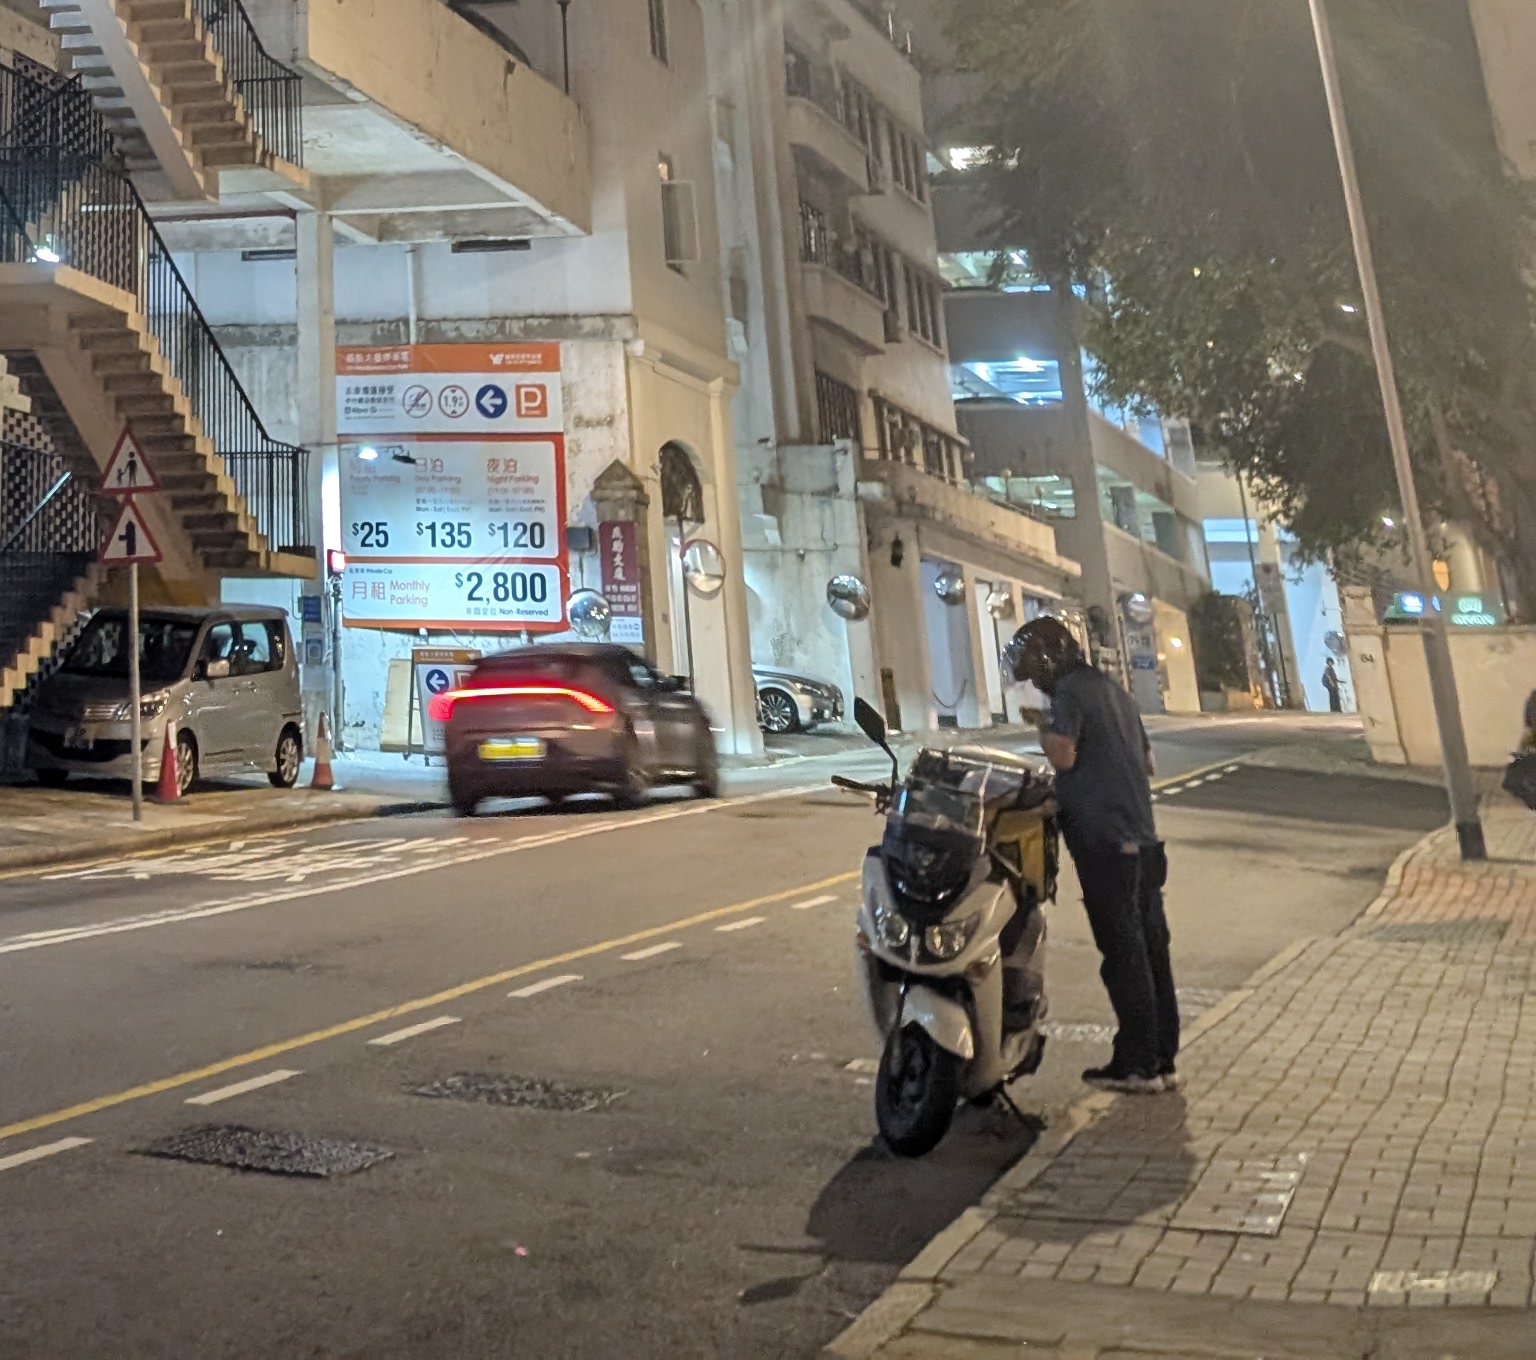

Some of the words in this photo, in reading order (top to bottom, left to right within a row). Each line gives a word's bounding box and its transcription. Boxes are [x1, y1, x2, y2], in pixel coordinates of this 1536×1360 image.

[520, 387, 542, 415] P
[415, 457, 443, 473] 日泊
[487, 458, 517, 473] 夜泊
[431, 474, 461, 485] Parking
[352, 521, 389, 548] $25
[416, 521, 472, 548] $135
[488, 521, 545, 549] $120
[352, 581, 386, 600] 月租
[390, 580, 431, 593] Monthly
[455, 571, 547, 605] $2,800
[390, 594, 428, 607] Parking
